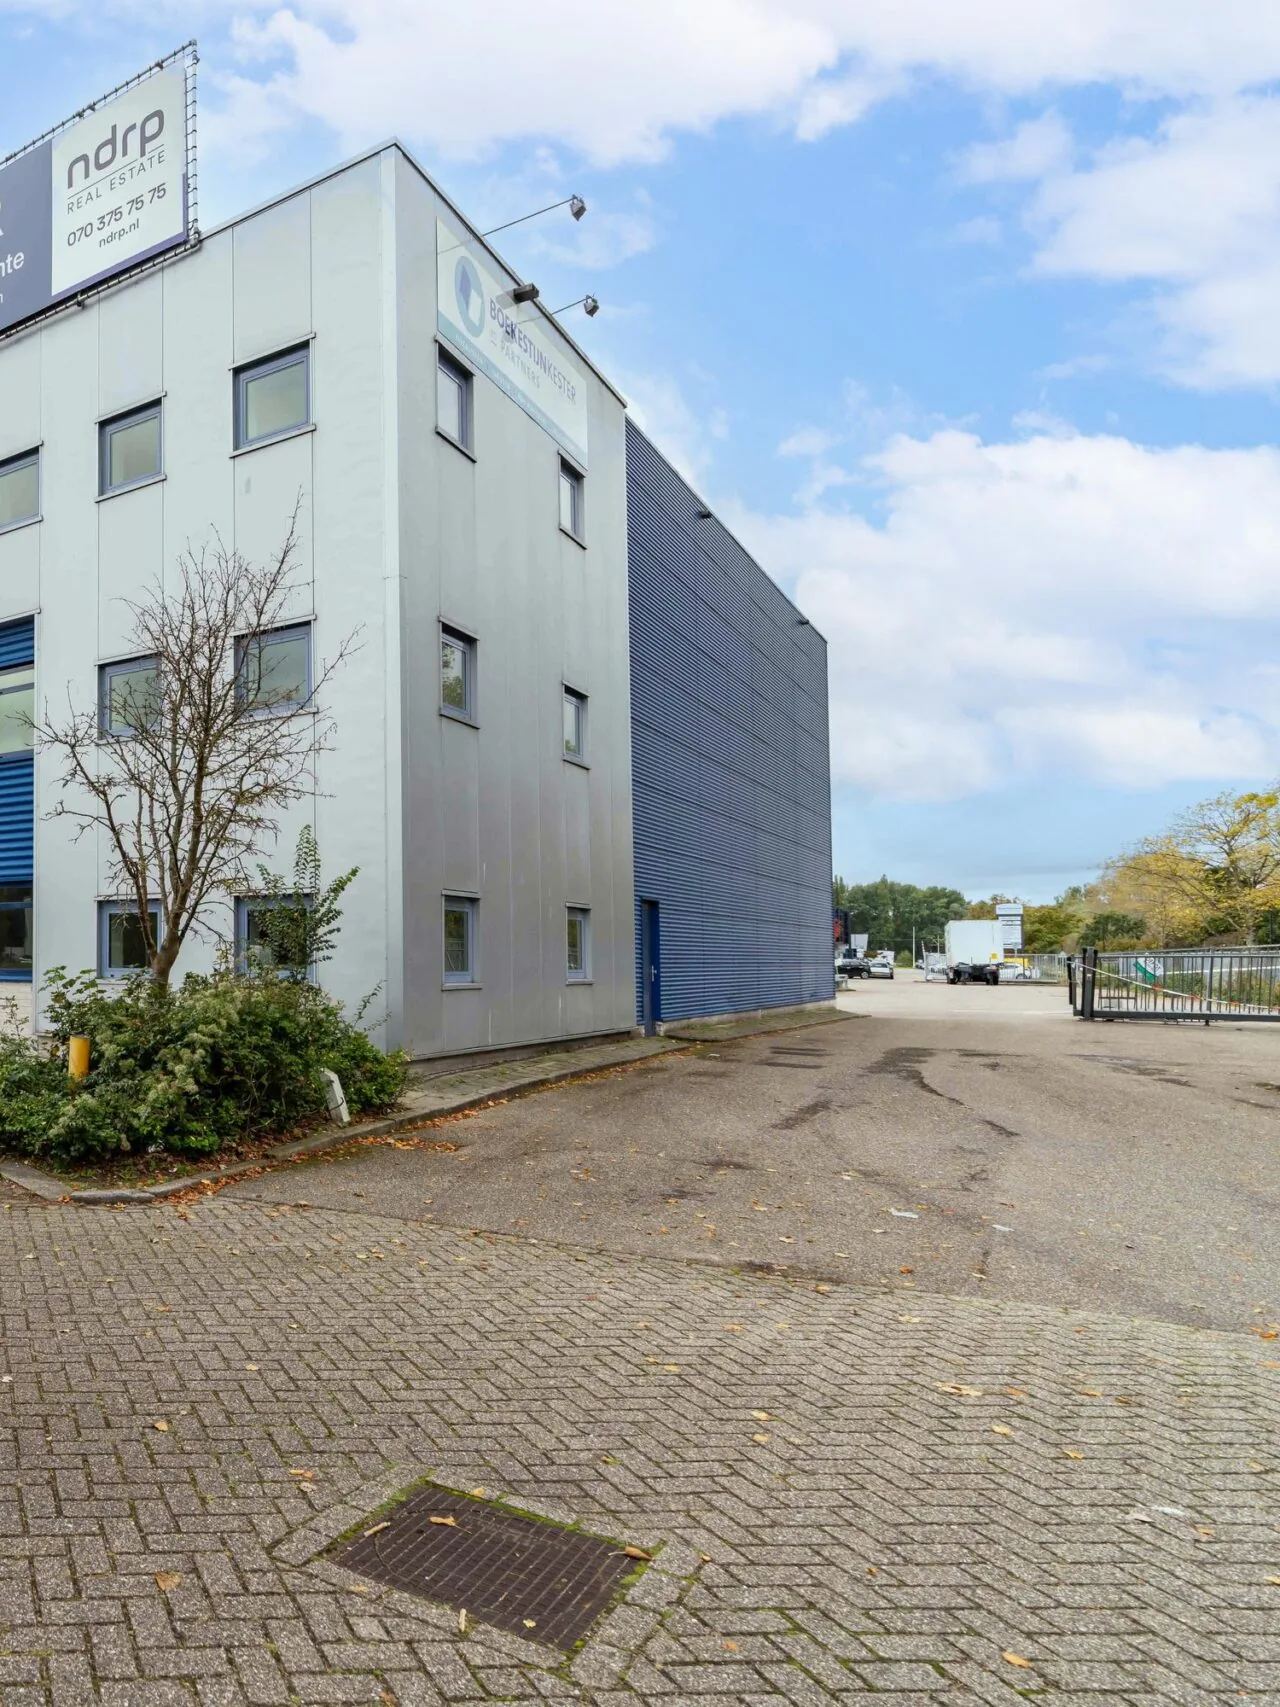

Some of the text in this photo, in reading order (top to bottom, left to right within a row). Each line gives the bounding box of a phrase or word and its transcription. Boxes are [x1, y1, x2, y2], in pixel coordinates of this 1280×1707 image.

[68, 109, 164, 190] ndrp
[67, 182, 166, 246] 070 375 75 75
[68, 150, 165, 214] REAL ESTATE
[99, 218, 139, 248] ndrp.nl
